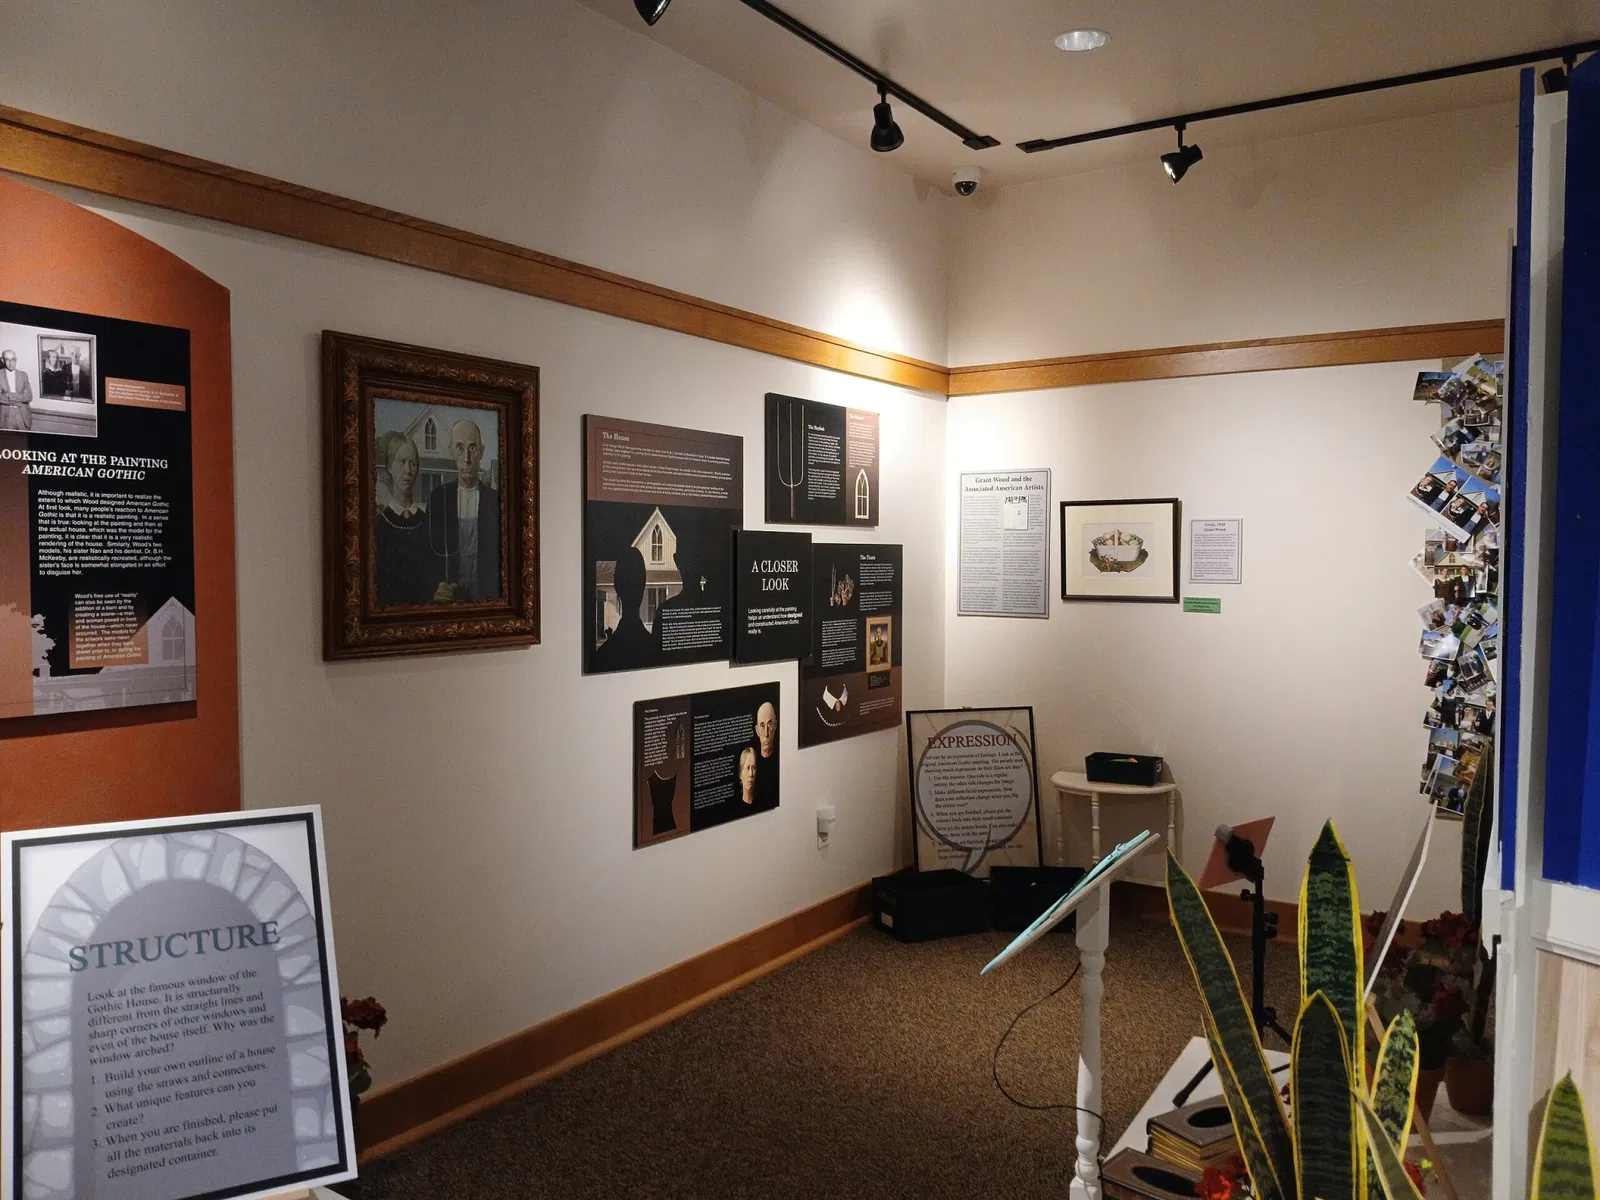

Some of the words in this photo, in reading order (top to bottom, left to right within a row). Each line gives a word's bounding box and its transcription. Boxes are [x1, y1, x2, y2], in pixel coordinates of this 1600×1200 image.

[602, 432, 613, 441] The
[613, 434, 630, 442] House
[0, 448, 57, 462] OOKING
[60, 453, 77, 464] AT
[80, 454, 107, 465] THE
[110, 456, 168, 469] PAINTING
[21, 464, 95, 478] AMERICAN
[97, 468, 146, 481] GOTHIC
[751, 560, 759, 573] A
[761, 559, 799, 573] CLOSER
[762, 578, 789, 591] LOOK
[927, 734, 1016, 748] EXPRESSION
[69, 921, 280, 972] STRUCTURE
[87, 1002, 122, 1014] Gothic
[165, 993, 172, 1002] It
[186, 983, 240, 1001] structurally
[88, 989, 115, 1002] Look
[117, 989, 127, 997] at
[130, 985, 146, 996] the
[149, 981, 185, 993] famous
[188, 974, 225, 986] window
[229, 970, 240, 980] of
[242, 969, 257, 979] the
[88, 1012, 132, 1027] different
[136, 1009, 160, 1019] from
[163, 1005, 178, 1015] the
[181, 999, 218, 1012] straight
[221, 996, 244, 1009] lines
[246, 991, 264, 1004] and
[88, 1028, 117, 1041] sharp
[120, 1022, 158, 1035] corners
[160, 1017, 172, 1028] of
[174, 1015, 200, 1026] other
[202, 1008, 246, 1021] windows
[249, 1003, 266, 1014] and
[89, 1041, 115, 1053] even
[117, 1036, 129, 1048] of
[131, 1036, 147, 1046] the
[150, 1031, 179, 1042] house
[182, 1024, 210, 1037] itself.
[213, 1021, 235, 1032] Why
[239, 1019, 258, 1028] was
[260, 1015, 274, 1024] the
[89, 1052, 130, 1065] window
[135, 1042, 174, 1058] arched?
[105, 1068, 134, 1083] Build
[137, 1066, 161, 1079] your
[164, 1062, 185, 1072] own
[188, 1055, 223, 1068] outline
[226, 1050, 238, 1061] of
[247, 1046, 275, 1057] house
[104, 1101, 133, 1113] What
[136, 1095, 171, 1108] unique
[175, 1088, 215, 1101] features
[217, 1084, 234, 1093] can
[237, 1080, 256, 1092] you
[105, 1086, 134, 1098] using
[137, 1082, 153, 1092] the
[156, 1077, 189, 1089] straws
[191, 1070, 210, 1082] and
[213, 1063, 268, 1079] connectors.
[92, 1139, 101, 1150] 3.
[105, 1133, 137, 1145] When
[140, 1129, 160, 1142] you
[163, 1125, 179, 1135] are
[183, 1114, 226, 1131] finished,
[229, 1109, 260, 1124] please
[262, 1104, 279, 1118] put
[106, 1113, 144, 1130] create?
[107, 1150, 120, 1163] all
[124, 1148, 141, 1159] the
[144, 1137, 192, 1155] materials
[195, 1131, 219, 1144] back
[222, 1128, 241, 1138] into
[244, 1124, 256, 1134] its
[107, 1157, 165, 1179] designated
[168, 1148, 218, 1166] container.
